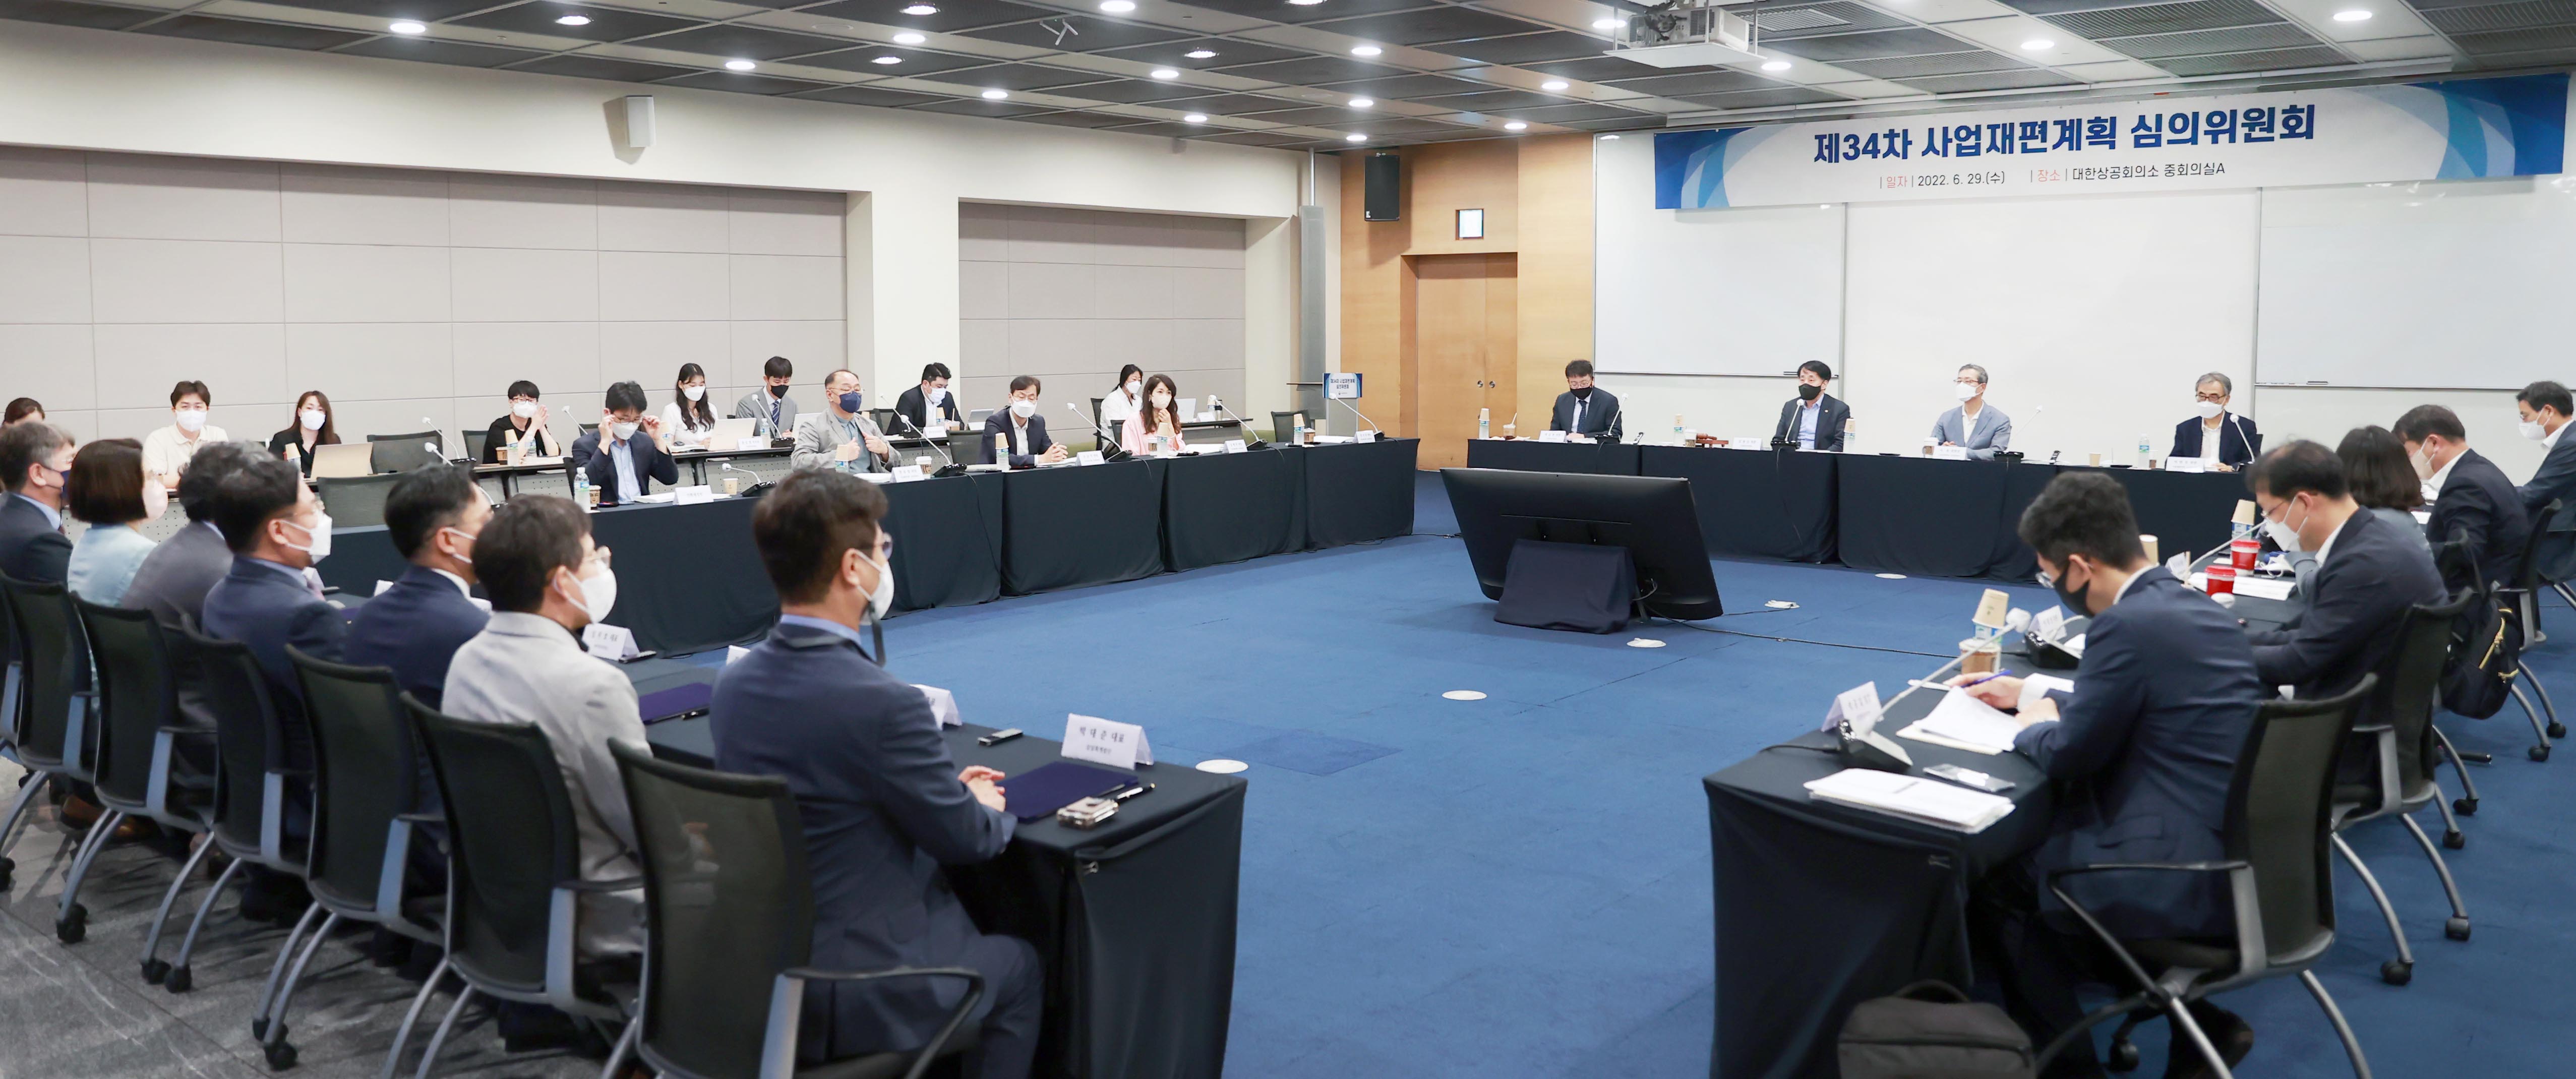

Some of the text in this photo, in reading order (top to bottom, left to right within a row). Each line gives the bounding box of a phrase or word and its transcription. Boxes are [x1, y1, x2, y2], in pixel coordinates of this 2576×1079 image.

[1814, 104, 2315, 163] 제34차 사업재편계획 심의위원회
[1886, 170, 2005, 189] 일자 2022. 6. 29.(수)
[2038, 162, 2226, 183] 장소 대한상공회의소 중회의실A
